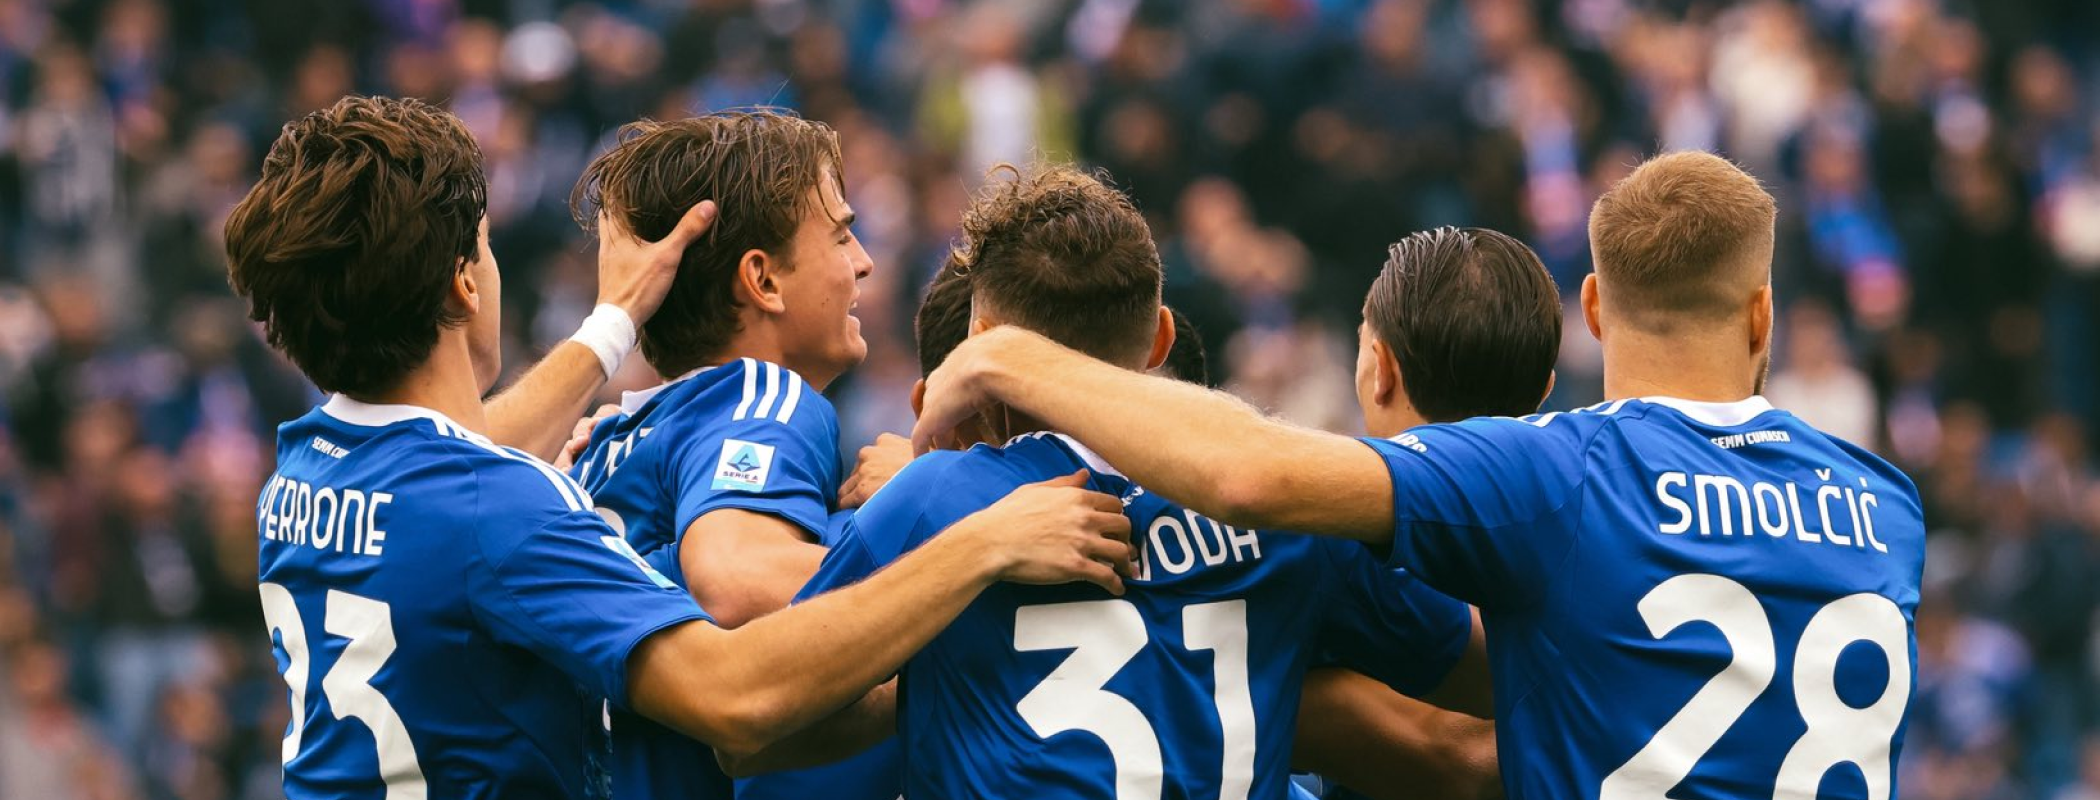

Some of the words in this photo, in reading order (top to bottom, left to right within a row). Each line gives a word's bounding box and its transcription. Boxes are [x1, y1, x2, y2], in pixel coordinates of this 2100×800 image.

[259, 473, 393, 556] PERRONE
[723, 471, 750, 479] SERIE
[1656, 468, 1888, 553] SMOLČIĆ
[1014, 598, 1256, 800] 31
[1600, 573, 1911, 800] 28
